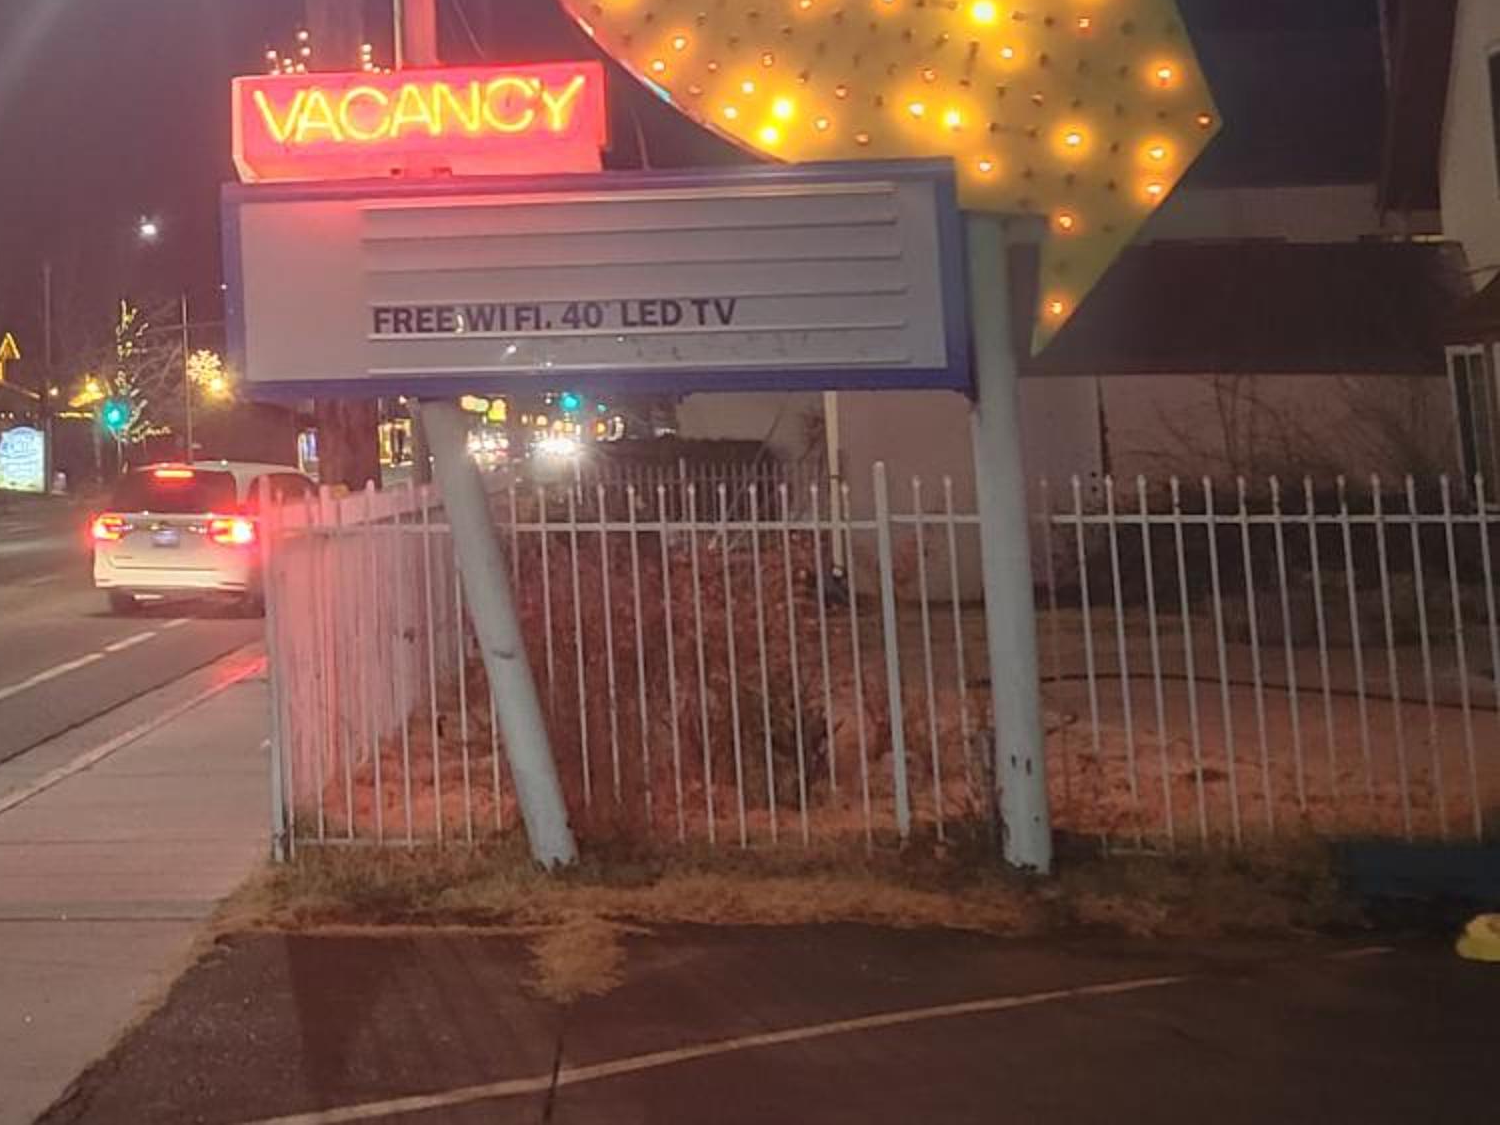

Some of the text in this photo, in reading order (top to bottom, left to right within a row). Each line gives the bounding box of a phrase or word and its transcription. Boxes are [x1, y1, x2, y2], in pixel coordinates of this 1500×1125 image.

[253, 75, 585, 143] VACANCY
[373, 306, 454, 333] FREE
[620, 299, 683, 327] LED
[691, 298, 737, 326] TV
